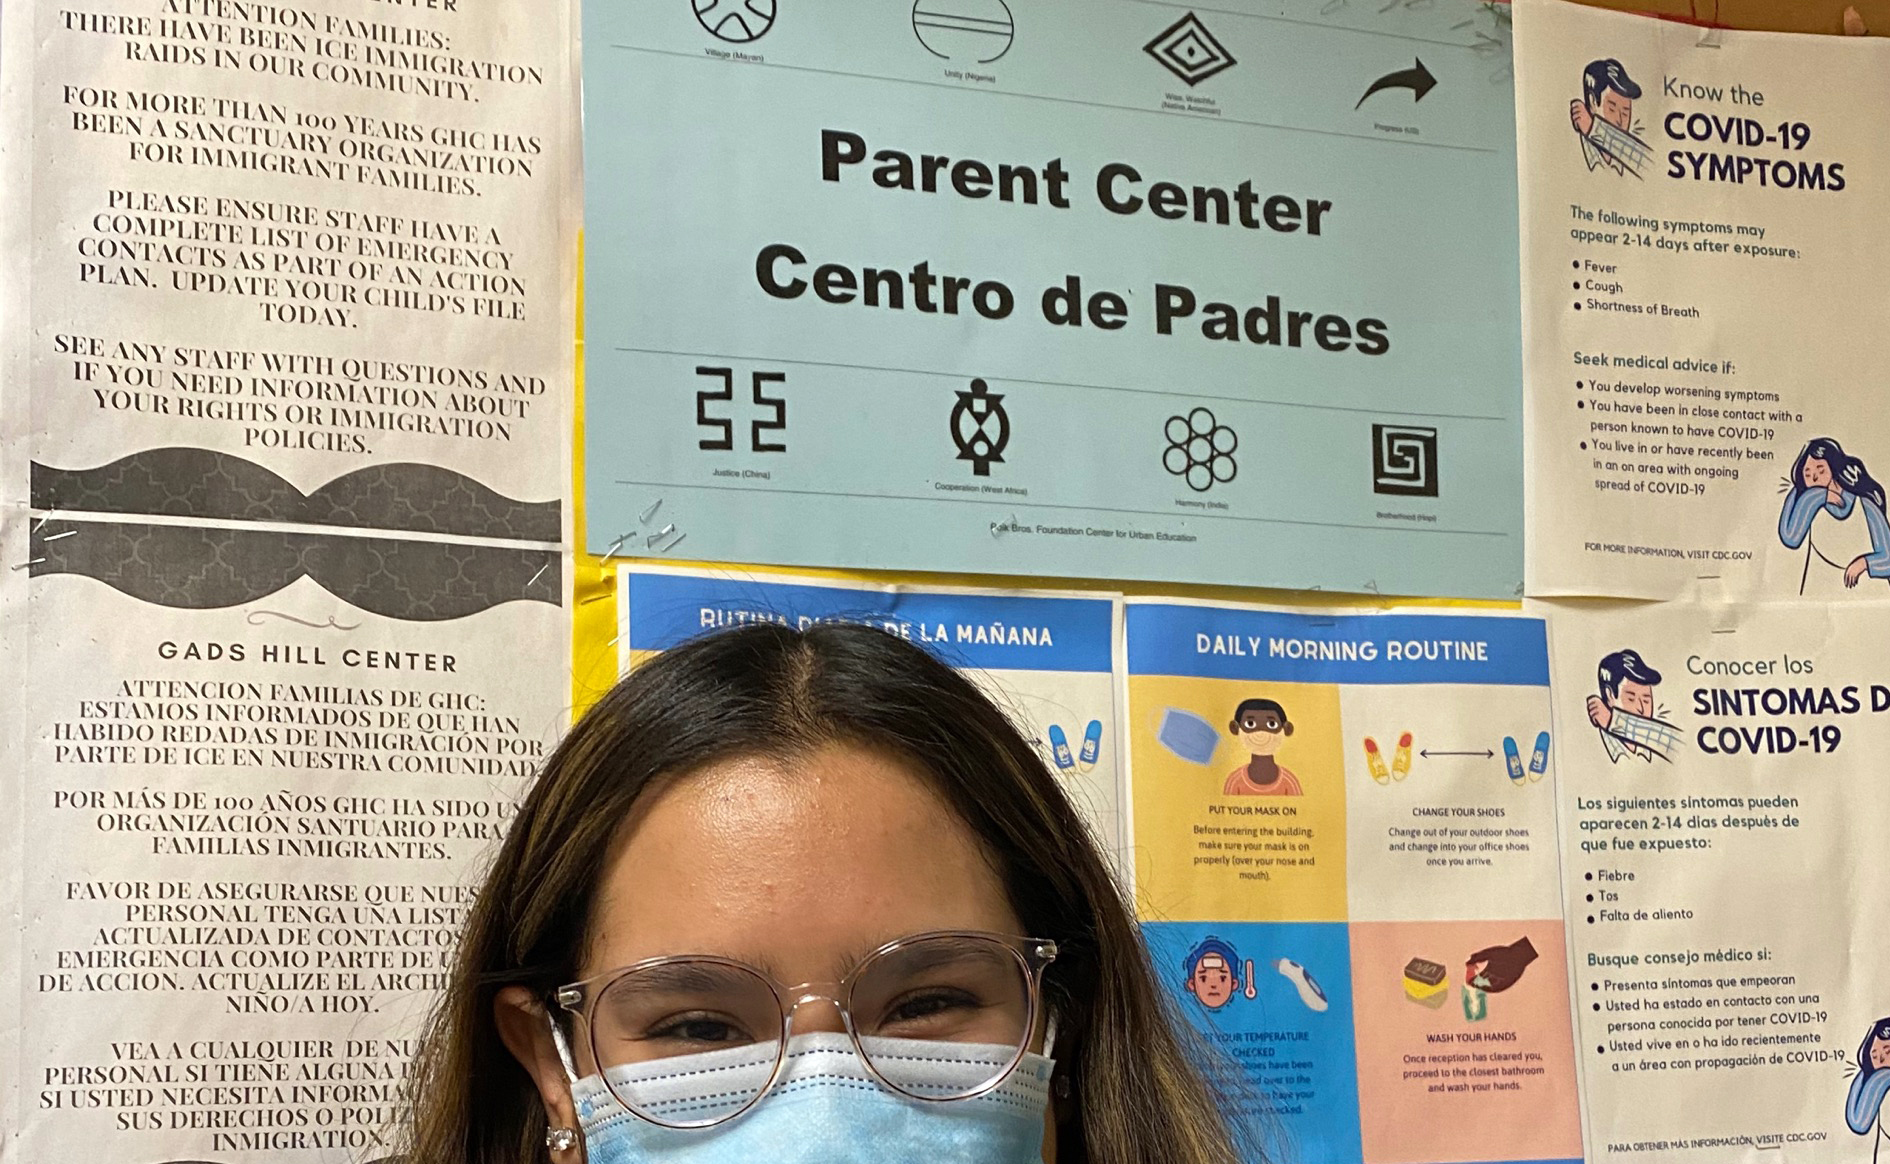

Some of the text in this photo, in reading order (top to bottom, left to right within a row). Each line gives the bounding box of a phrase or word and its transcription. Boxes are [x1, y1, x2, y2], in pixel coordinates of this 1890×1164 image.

[60, 10, 541, 84] THERE HAVE BEEN ICE IMMIGRATION
[1664, 76, 1764, 106] Know the
[64, 86, 540, 154] FOR MORE THAN 100 YEARS GHC HAS
[1664, 112, 1810, 150] COVID-19
[1668, 150, 1845, 191] SYMPTOMS
[822, 130, 1332, 236] Parent Center
[110, 190, 500, 245] PLEASE ENSURE STAFF HAVE A
[1571, 205, 1765, 240] The following symptoms may
[94, 214, 512, 270] COMPLETE LIST OF EMERGENCY
[1571, 229, 1800, 258] appear 2-14 days after exposure:
[1585, 260, 1617, 274] Fever
[1586, 279, 1623, 294] Cough
[756, 244, 1389, 355] Centro de Padres
[1587, 298, 1699, 318] Shortness of Breath
[55, 335, 545, 394] SEE ANY STAFF WITH QUESTIONS AND
[1574, 352, 1735, 374] Seek medical advice if:
[1589, 380, 1779, 402] You develop worsening symptoms
[712, 468, 770, 480] Justice (China)
[935, 482, 980, 492] Cooperation
[1004, 487, 1027, 496] Africa)
[1011, 523, 1196, 542] Bros. Foundation Center for Urban Education
[922, 622, 1053, 647] LA MAÑANA
[158, 642, 456, 672] GADS HILL CENTER
[1197, 634, 1488, 661] DAILY MORNING ROUTINE
[1687, 654, 1813, 676] Conocer los
[117, 680, 484, 711] ATTENCION FAMILIAS DE GHC:
[1693, 686, 1860, 716] SINTOMAS
[1697, 725, 1841, 754] COVID-19
[1209, 806, 1296, 816] PUT YOUR MASK ON
[1413, 808, 1505, 817] CHANGE YOUR SHOES
[154, 837, 451, 859] FAMILIAS INMIGRANTES.
[1581, 836, 1711, 854] que fue expuesto:
[1598, 869, 1634, 881] Fiebre
[68, 882, 414, 906] FAVOR DE ASEGURARSE QUE
[1599, 890, 1618, 902] Tos
[1600, 909, 1693, 922] Falta de aliento
[58, 950, 433, 968] EMERGENCIA COMO PARTE DE
[1588, 953, 1639, 968] Busque
[1644, 950, 1699, 966] consejo
[1758, 947, 1771, 960] si:
[1608, 1011, 1827, 1034] persona conocida por tener COVID-19
[1426, 1032, 1516, 1043] WASH YOUR HANDS
[1403, 1054, 1426, 1064] Once
[1428, 1054, 1470, 1064] reception
[1472, 1052, 1487, 1062] has
[1489, 1052, 1522, 1061] cleared
